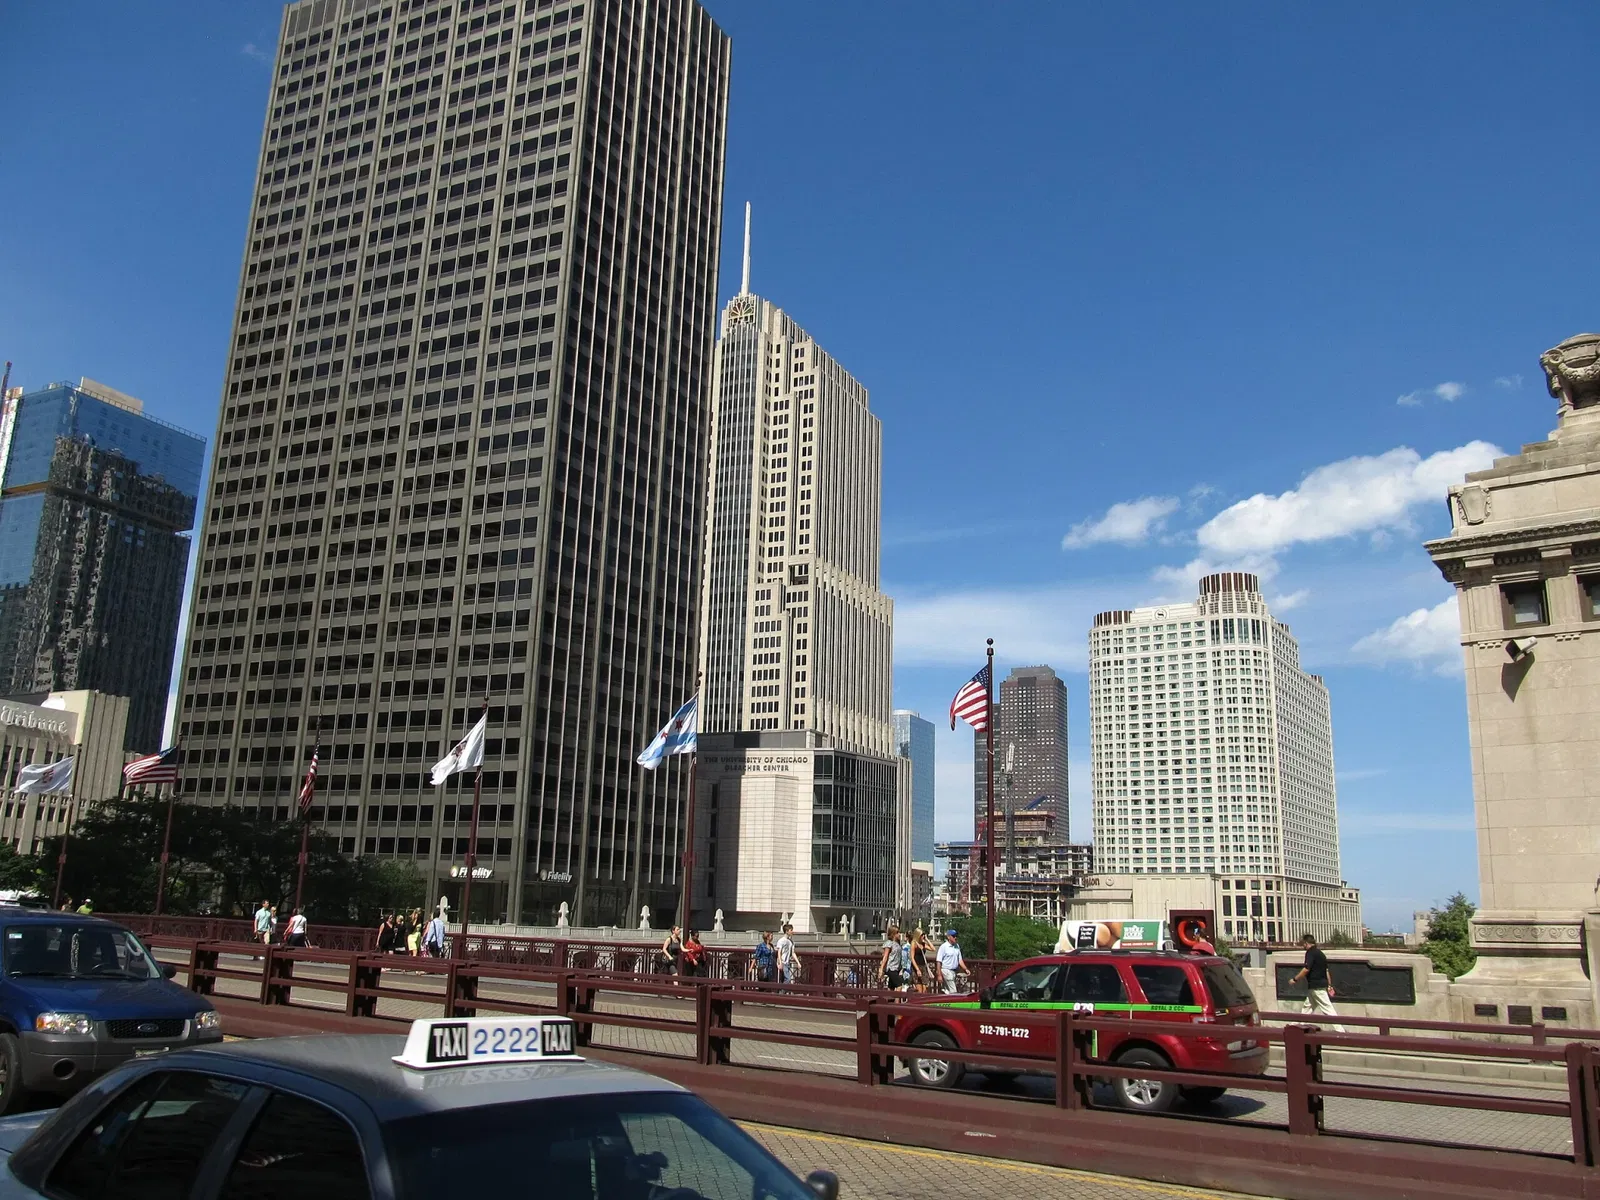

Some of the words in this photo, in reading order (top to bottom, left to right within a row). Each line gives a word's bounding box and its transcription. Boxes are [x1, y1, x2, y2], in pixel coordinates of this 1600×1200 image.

[1, 705, 67, 733] Tribune
[458, 867, 492, 879] Fielity
[547, 871, 572, 882] Fidelity
[980, 1025, 1030, 1038] 312-791-1272
[433, 1027, 467, 1058] TAXI
[474, 1027, 538, 1055] 2222
[543, 1024, 571, 1052] TAXI
